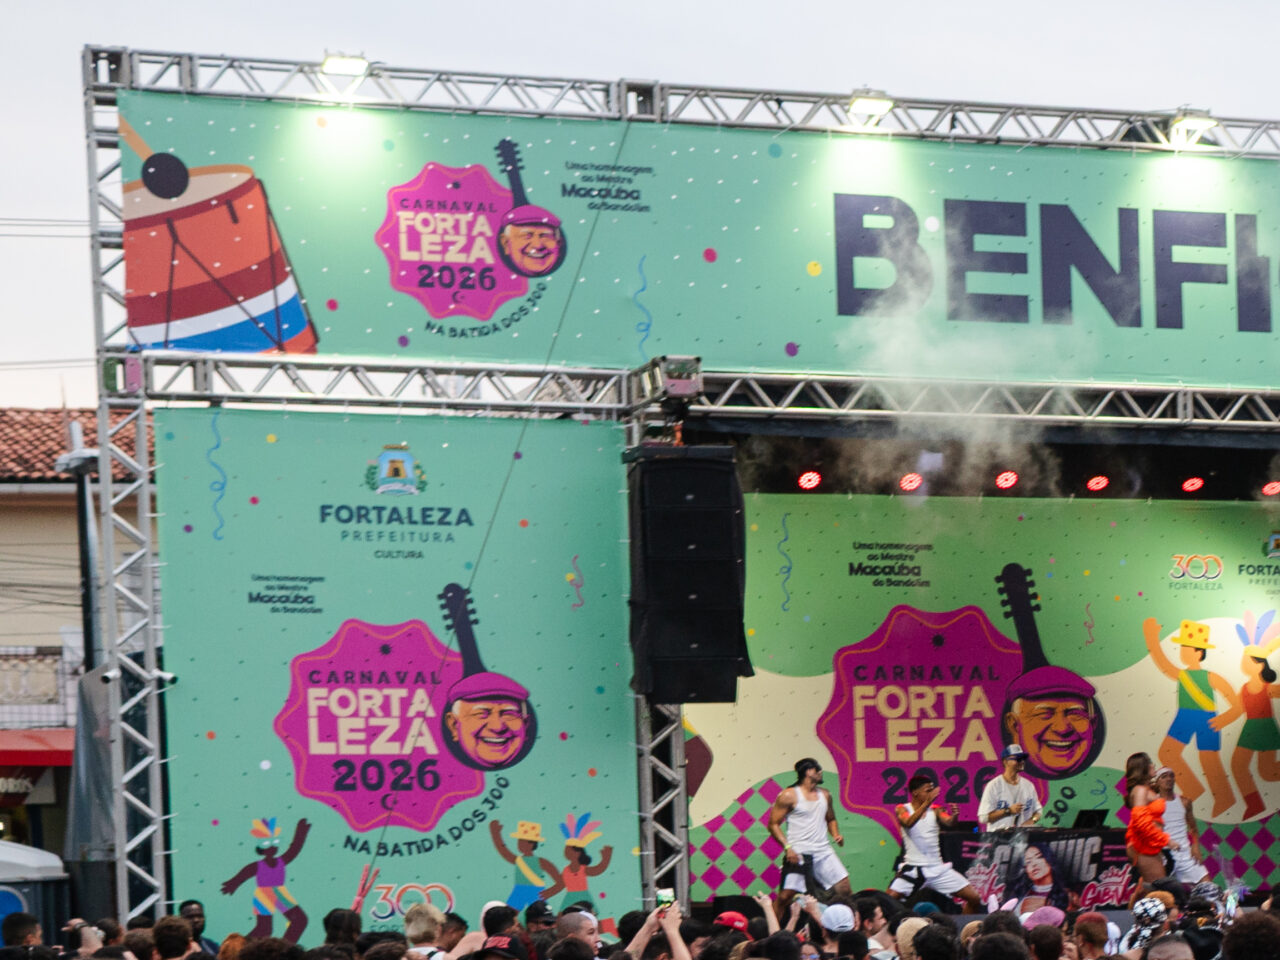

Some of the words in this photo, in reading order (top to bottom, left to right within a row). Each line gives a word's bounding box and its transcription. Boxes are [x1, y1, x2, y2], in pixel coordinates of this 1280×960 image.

[400, 198, 498, 213] CARNAVAL
[397, 211, 493, 237] FORTA
[400, 233, 495, 264] LEZA
[417, 264, 496, 291] 2026
[319, 505, 474, 527] FORTALEZA
[341, 530, 455, 543] PREFEITURA
[374, 550, 424, 559] CULTURA
[1169, 554, 1224, 581] 300
[848, 562, 921, 576] Macaúba
[1169, 582, 1223, 591] FORTALEZA
[308, 670, 443, 685] CARNAVAL
[853, 665, 1000, 682] CARNAVAL
[307, 687, 436, 718] FORTA
[852, 685, 995, 719] FORTA
[307, 717, 439, 755] LEZA
[853, 718, 998, 762] LEZA
[332, 759, 440, 791] 2026
[343, 835, 372, 855] NA
[376, 834, 449, 857] BATIDA
[448, 809, 487, 841] DOS
[481, 776, 510, 811] 300
[1044, 786, 1077, 825] 300
